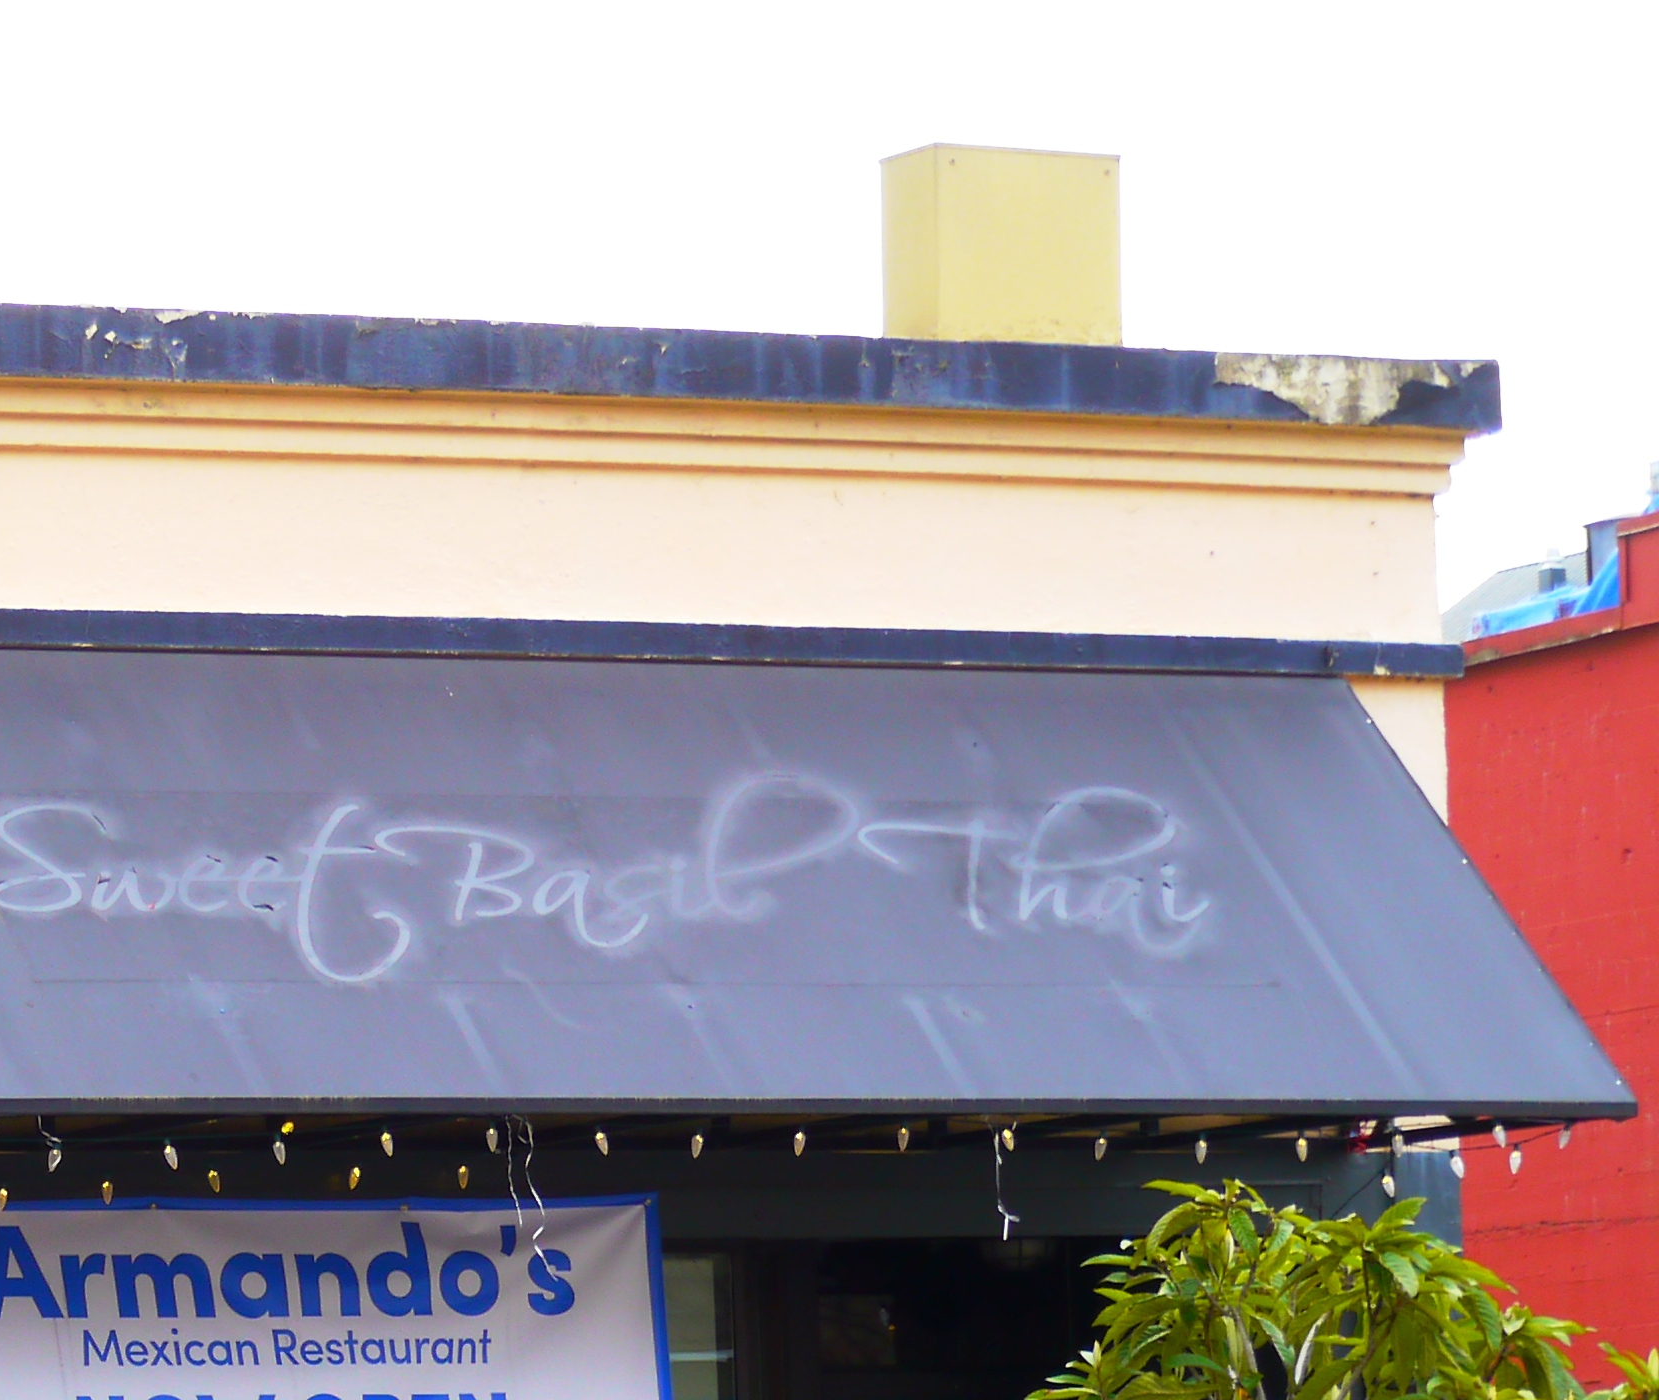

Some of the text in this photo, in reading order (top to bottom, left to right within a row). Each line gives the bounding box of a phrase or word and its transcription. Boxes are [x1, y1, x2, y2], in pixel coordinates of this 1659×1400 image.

[376, 773, 857, 952] Basil
[857, 786, 1211, 955] Thai
[82, 1328, 492, 1368] Mexican Restaurant
